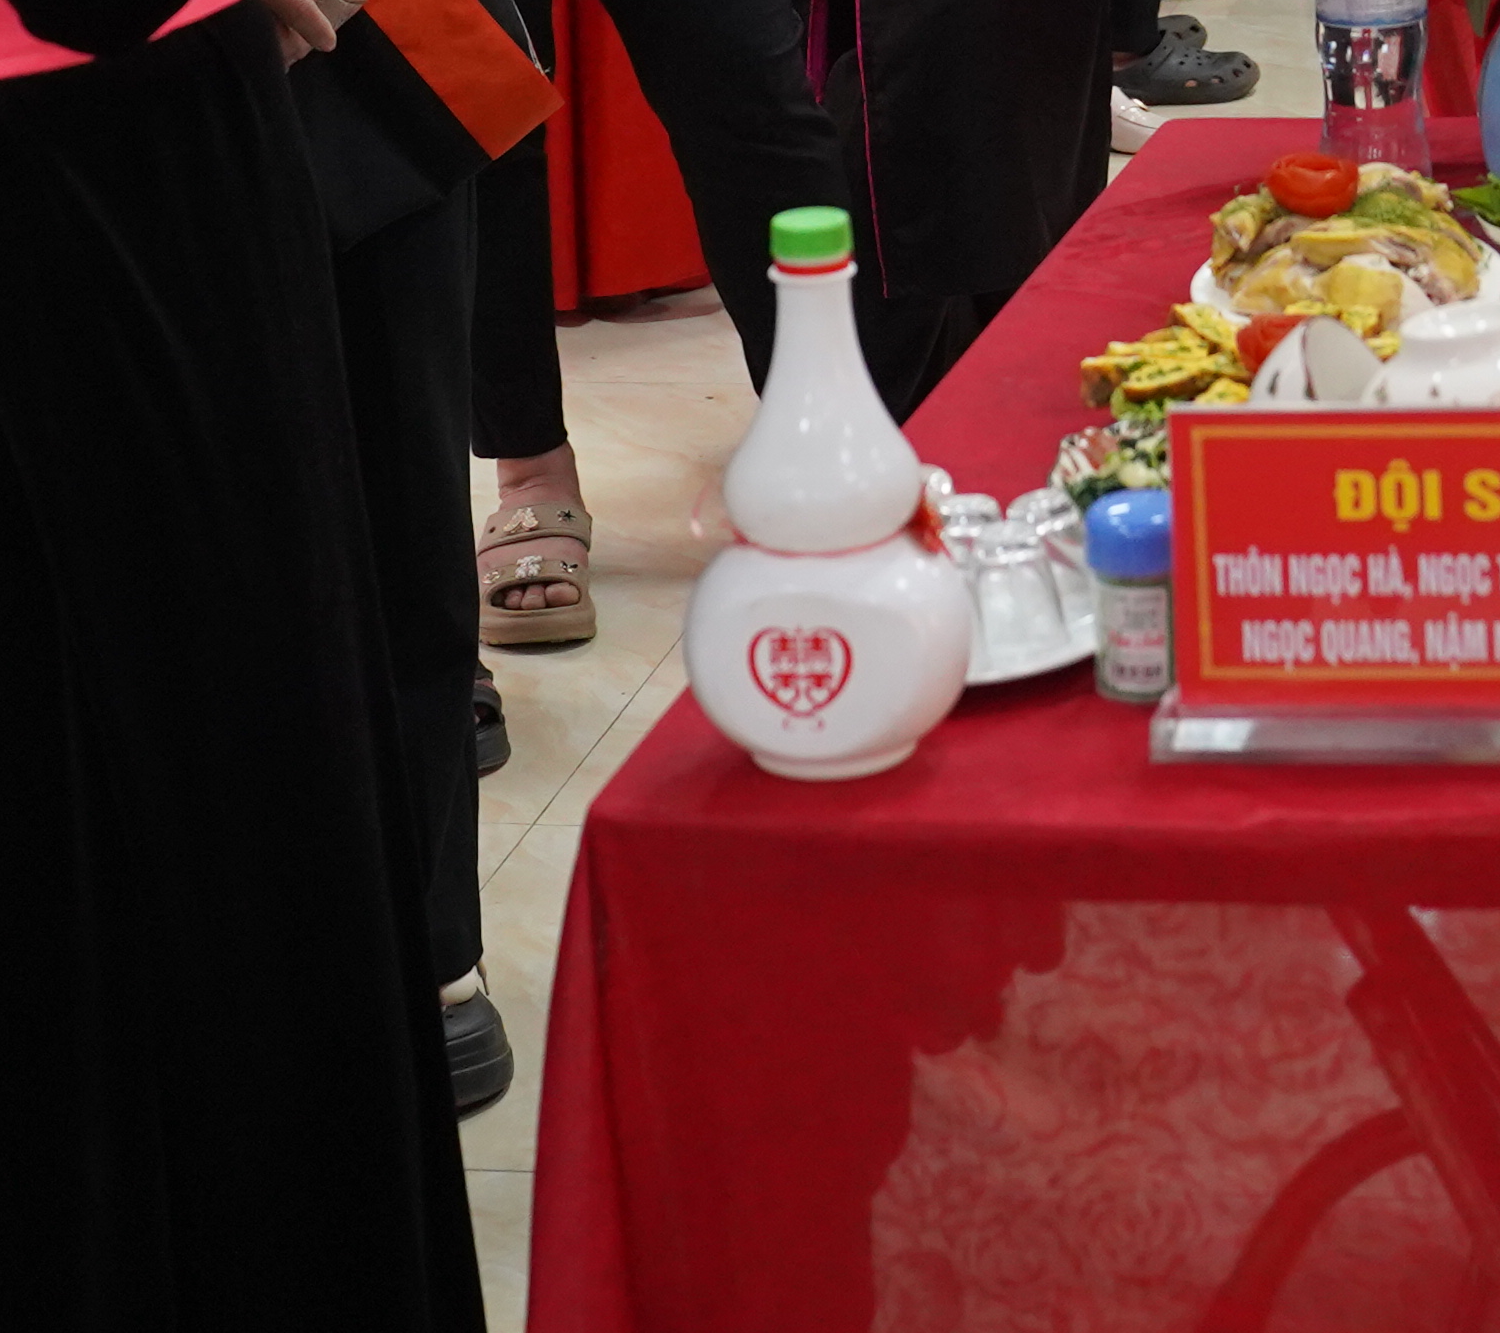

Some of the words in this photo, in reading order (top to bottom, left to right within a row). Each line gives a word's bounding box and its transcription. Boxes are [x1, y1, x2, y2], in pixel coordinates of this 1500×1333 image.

[1333, 457, 1444, 533] ĐỘI
[1212, 544, 1283, 598] THÔN
[1287, 552, 1362, 606] NGỌC
[1416, 552, 1493, 606] NGỌC
[1241, 619, 1316, 674] NGỌC
[1319, 619, 1421, 668] QUANG,
[1423, 611, 1488, 673] NẬM
